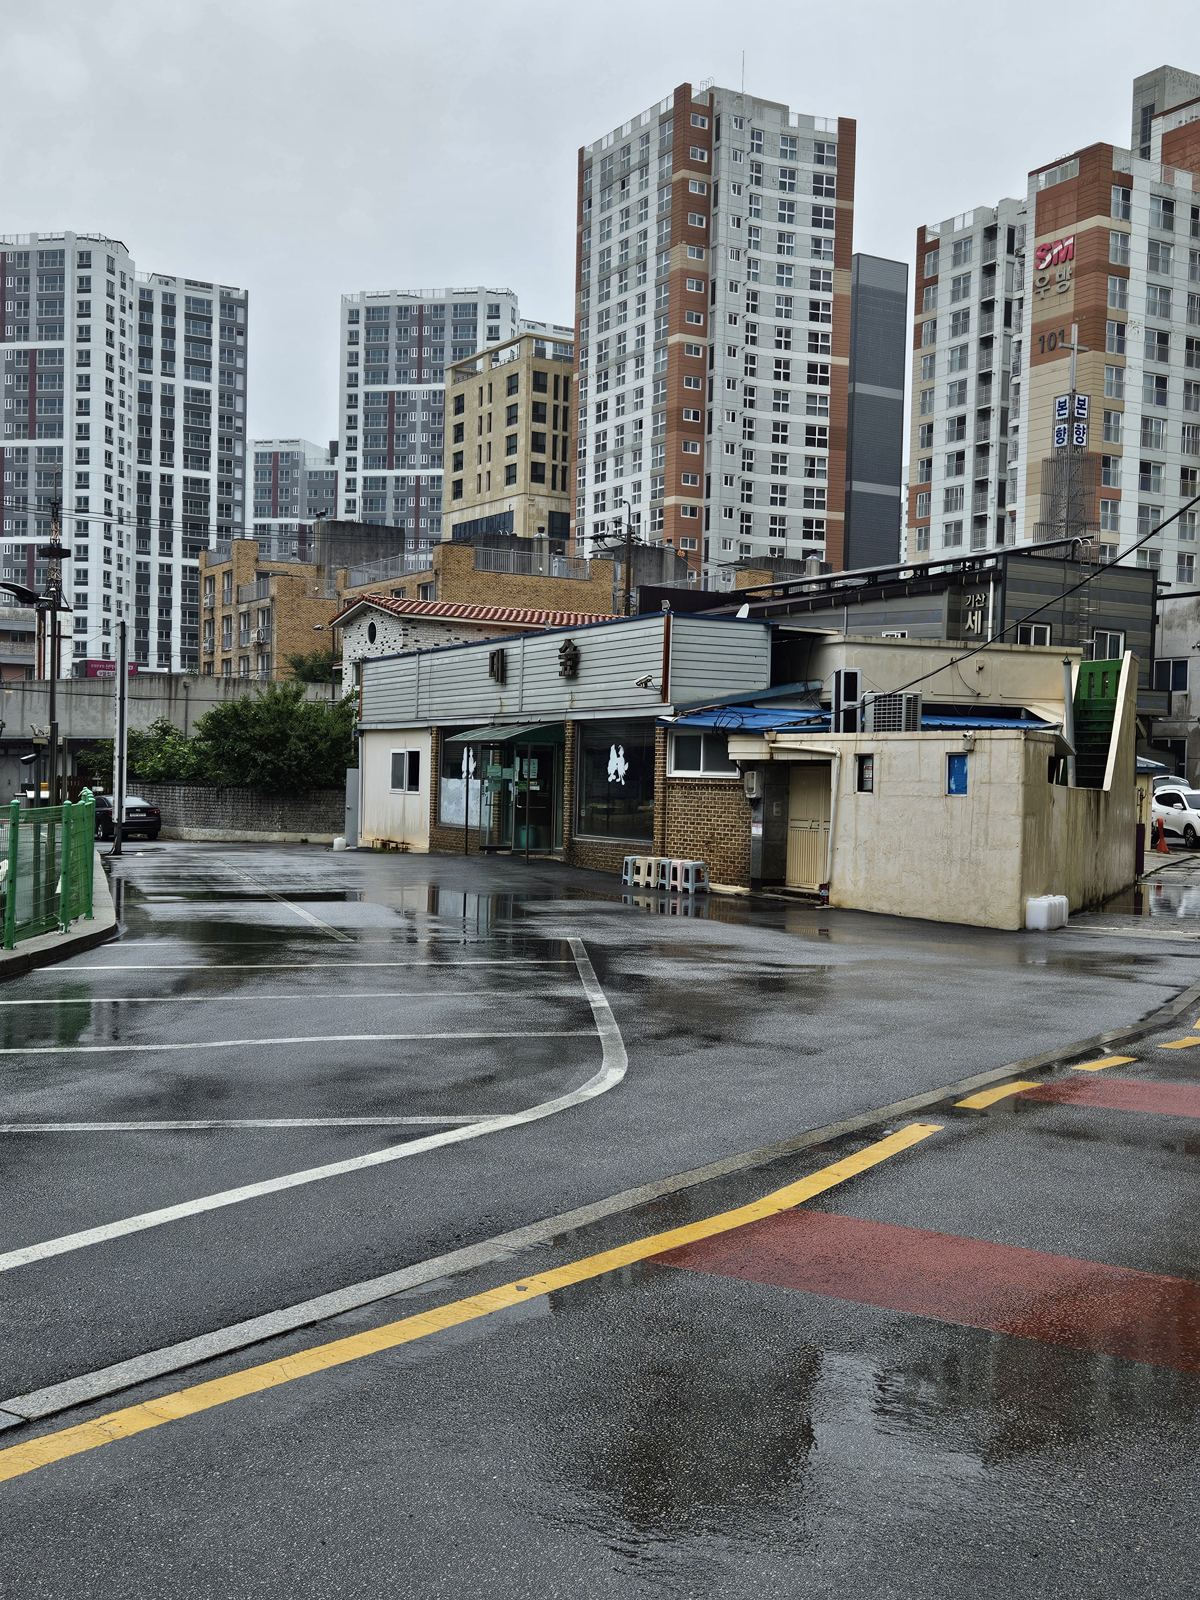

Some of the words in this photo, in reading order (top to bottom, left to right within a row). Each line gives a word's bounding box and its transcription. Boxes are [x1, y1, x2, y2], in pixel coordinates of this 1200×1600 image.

[1035, 236, 1076, 271] SM
[1034, 269, 1074, 298] 우방
[1038, 328, 1064, 355] 101
[965, 593, 986, 608] 기산
